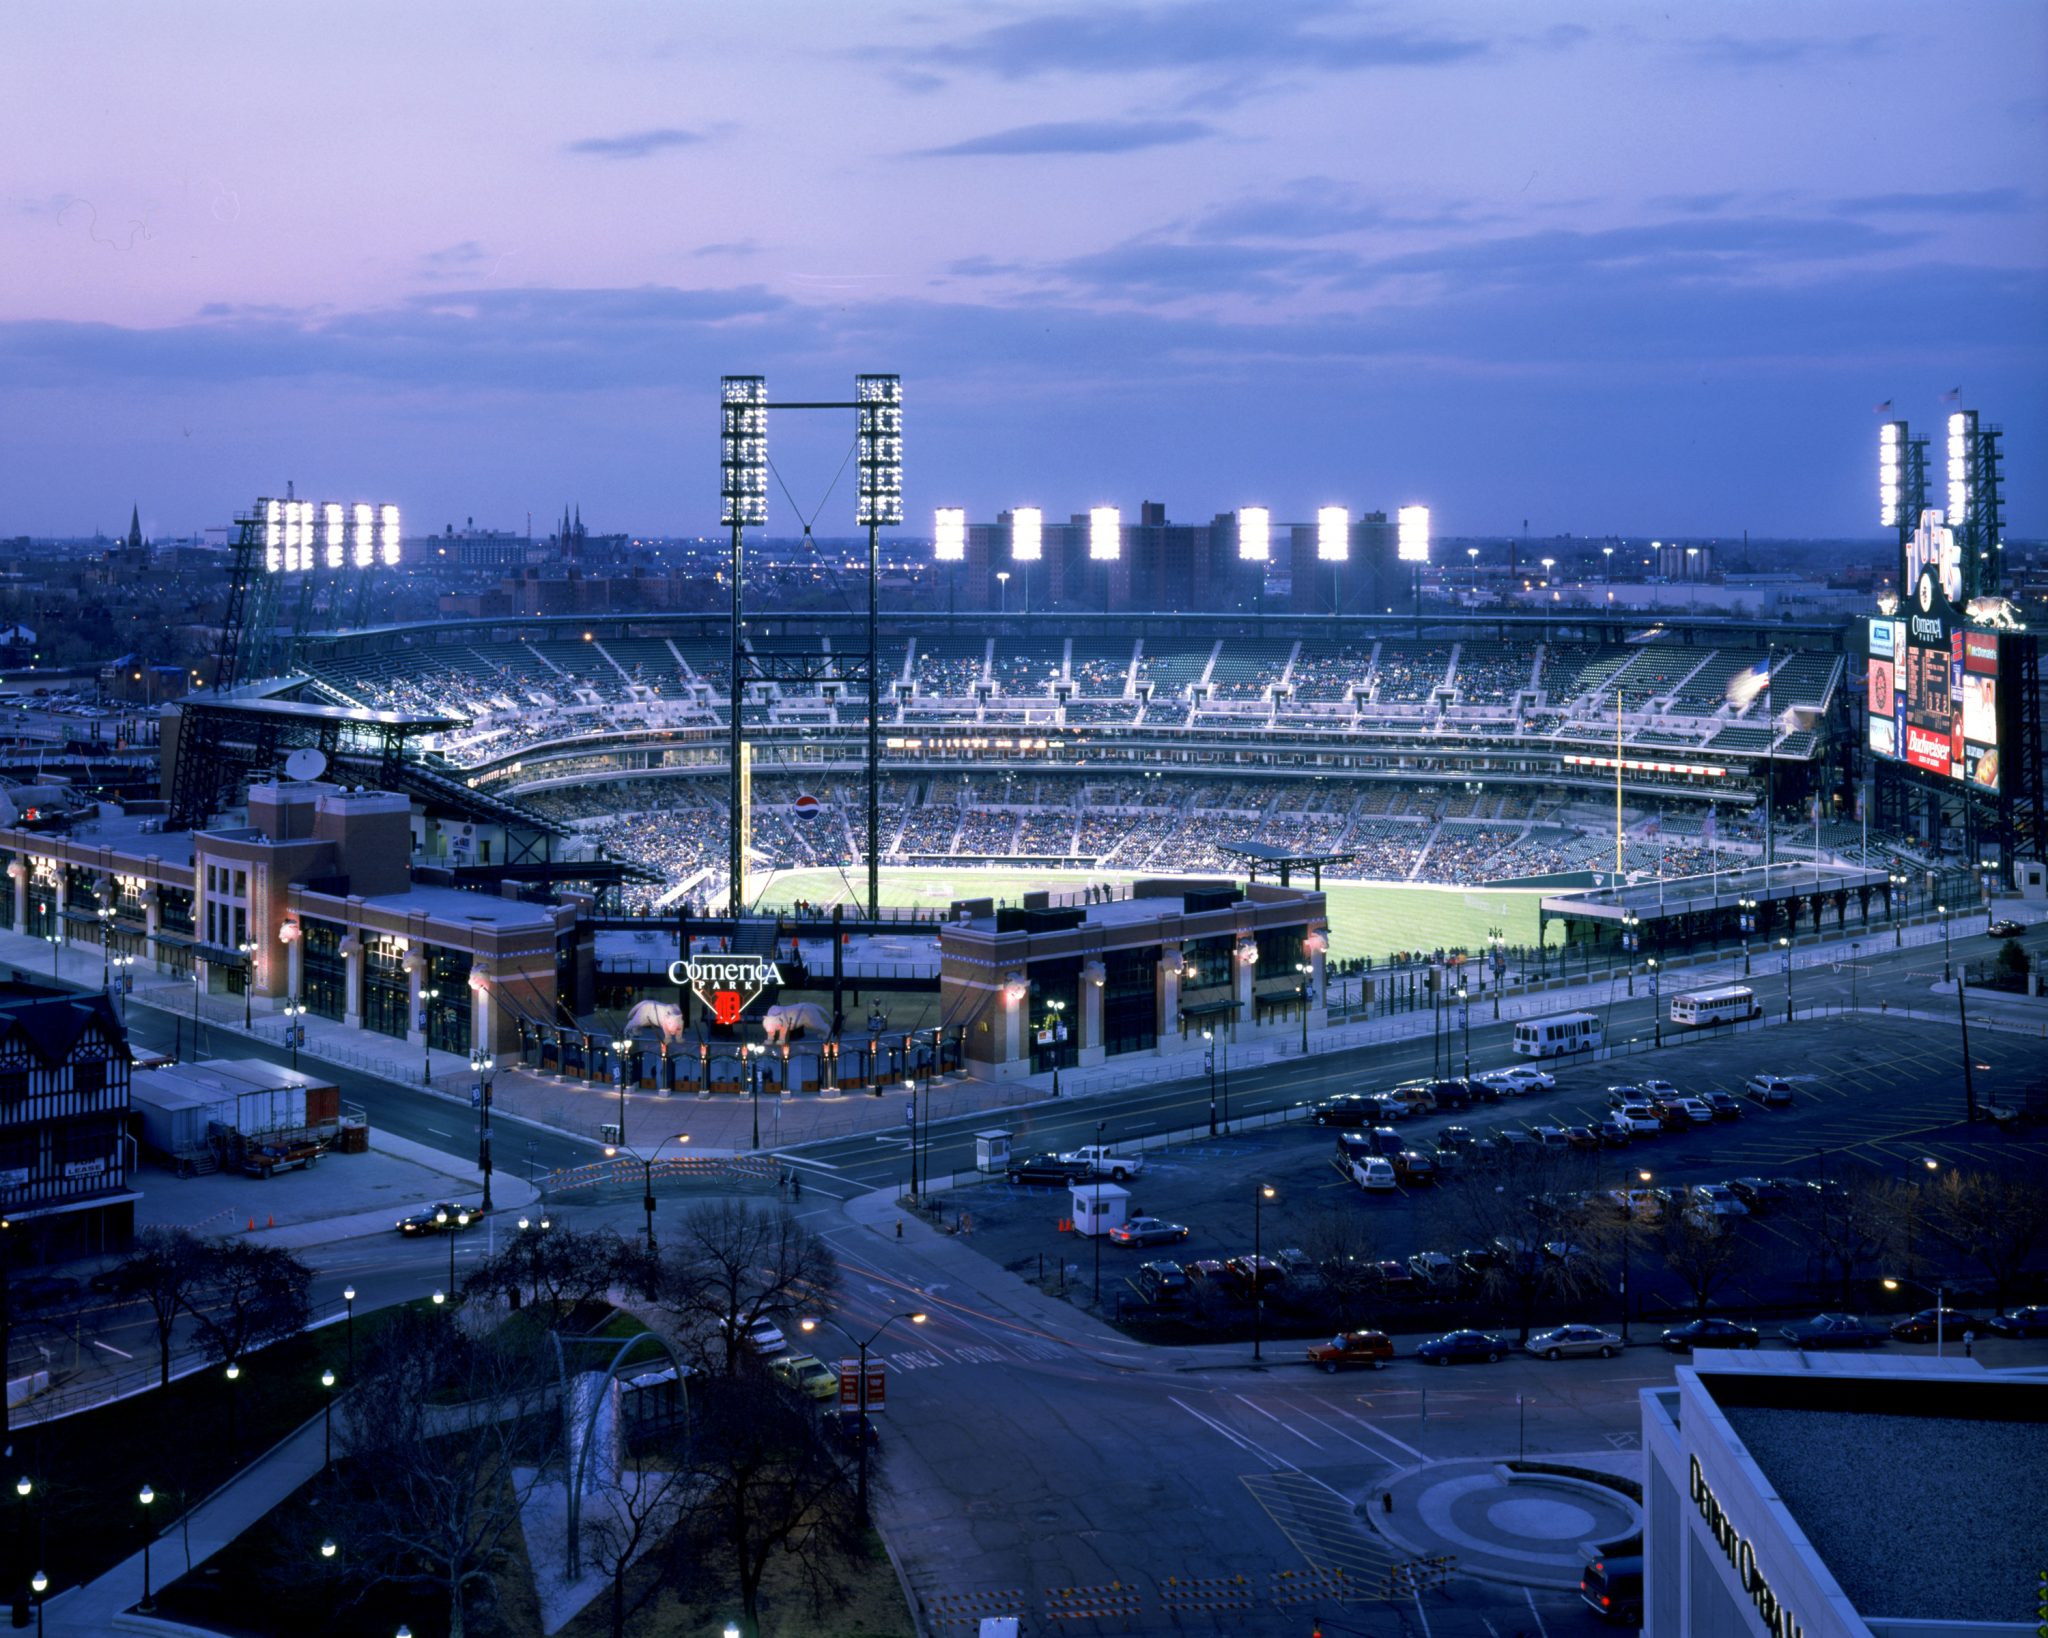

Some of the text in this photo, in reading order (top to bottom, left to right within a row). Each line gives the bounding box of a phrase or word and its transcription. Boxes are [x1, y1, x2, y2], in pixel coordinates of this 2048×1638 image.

[1919, 633, 1934, 642] PARK
[1908, 730, 1950, 760] Budweiser
[698, 980, 753, 990] PARK
[67, 1164, 102, 1175] LEASE
[891, 1349, 944, 1370] ONLY
